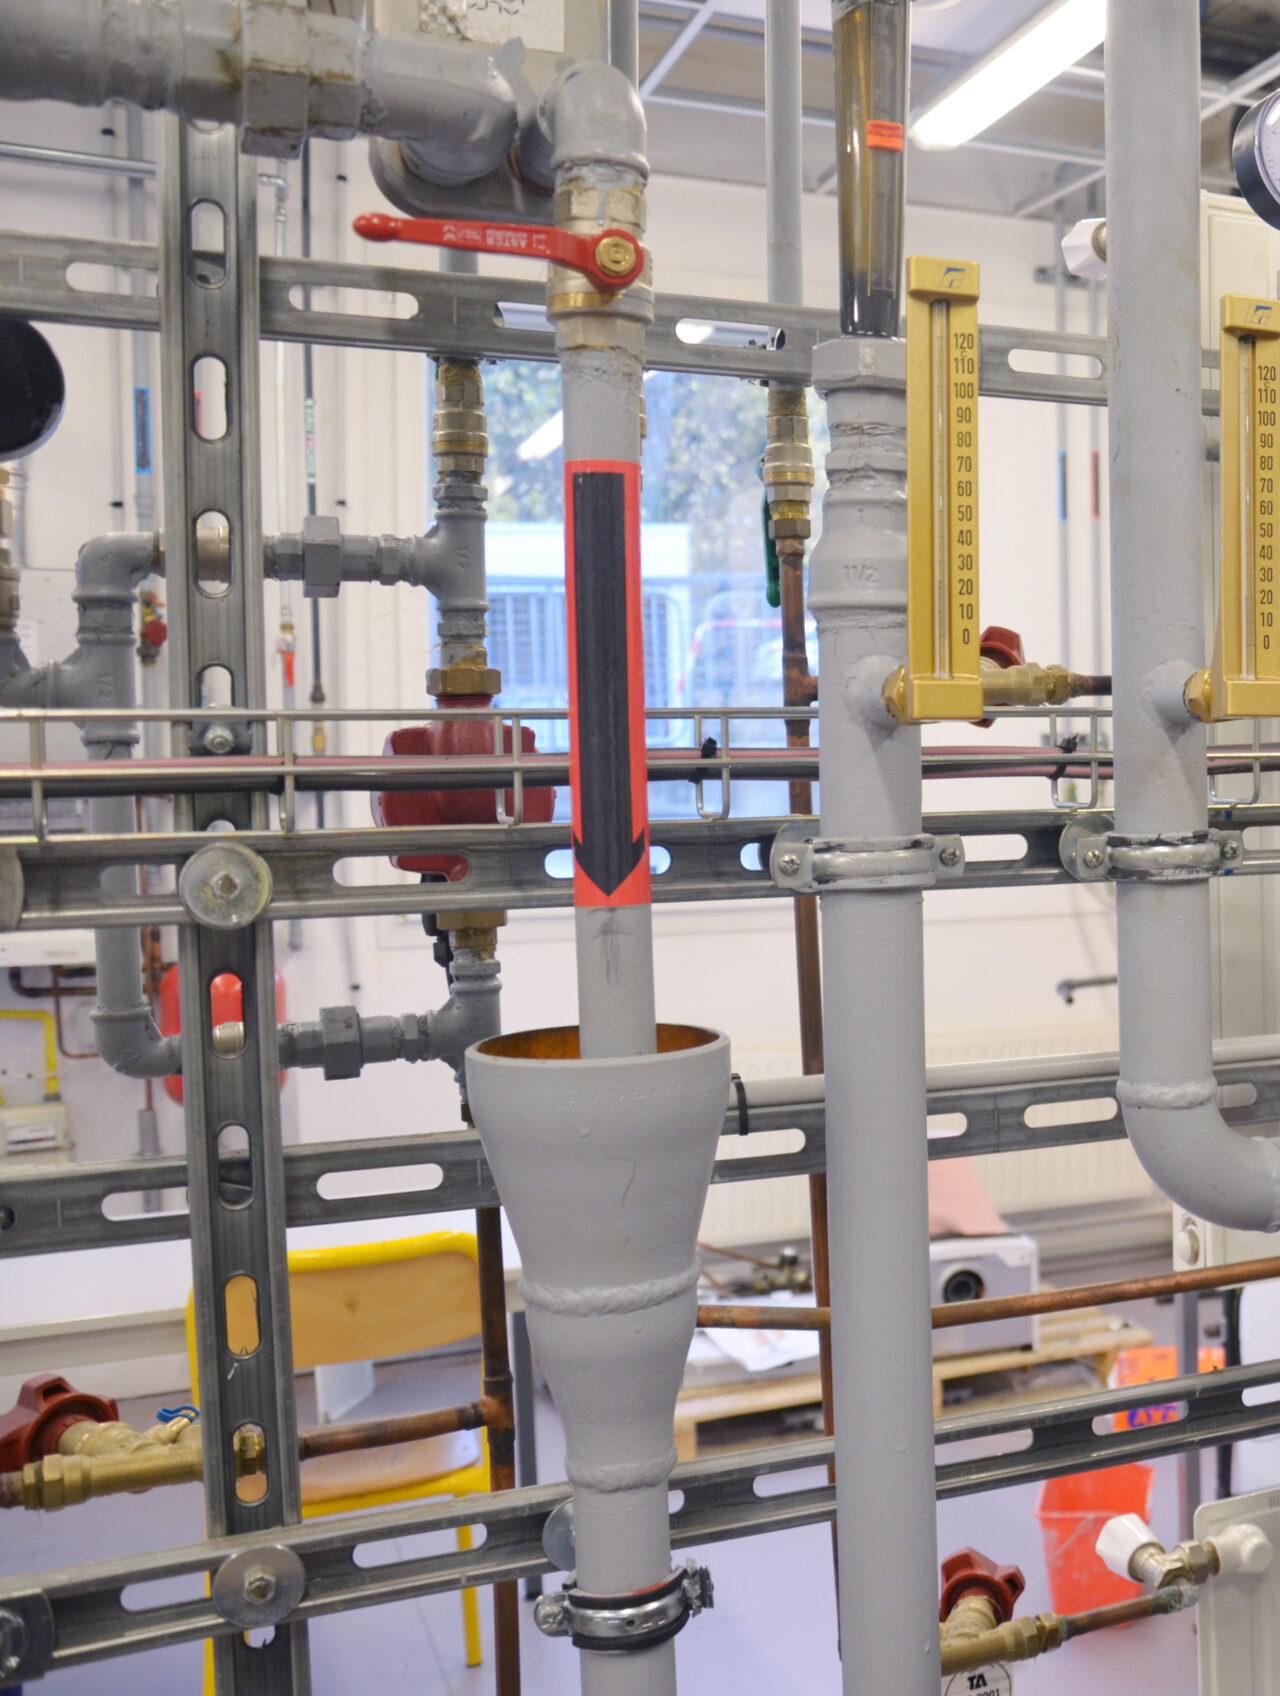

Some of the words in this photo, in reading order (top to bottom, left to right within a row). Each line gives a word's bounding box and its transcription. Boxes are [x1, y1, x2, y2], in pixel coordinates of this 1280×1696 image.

[954, 333, 974, 350] 120
[954, 357, 974, 375] 110
[1258, 365, 1276, 381] 120
[954, 382, 974, 399] 100
[1258, 388, 1276, 404] 110
[957, 407, 972, 424] 90
[1258, 410, 1276, 426] 100
[957, 431, 972, 448] 80
[1260, 433, 1273, 448] 90
[957, 456, 973, 472] 70
[1260, 455, 1273, 471] 80
[958, 480, 973, 497] 60
[1261, 478, 1273, 493] 70
[958, 505, 973, 521] 50
[1260, 500, 1273, 515] 60
[958, 529, 973, 546] 40
[1260, 522, 1273, 538] 50
[1260, 545, 1273, 560] 40
[958, 554, 973, 570] 30
[1260, 567, 1273, 582] 30
[959, 579, 973, 595] 20
[1260, 589, 1273, 605] 20
[960, 603, 974, 620] 10
[1260, 612, 1273, 627] 10
[962, 627, 971, 645] 0
[1263, 634, 1271, 649] 0
[967, 1673, 988, 1690] TA
